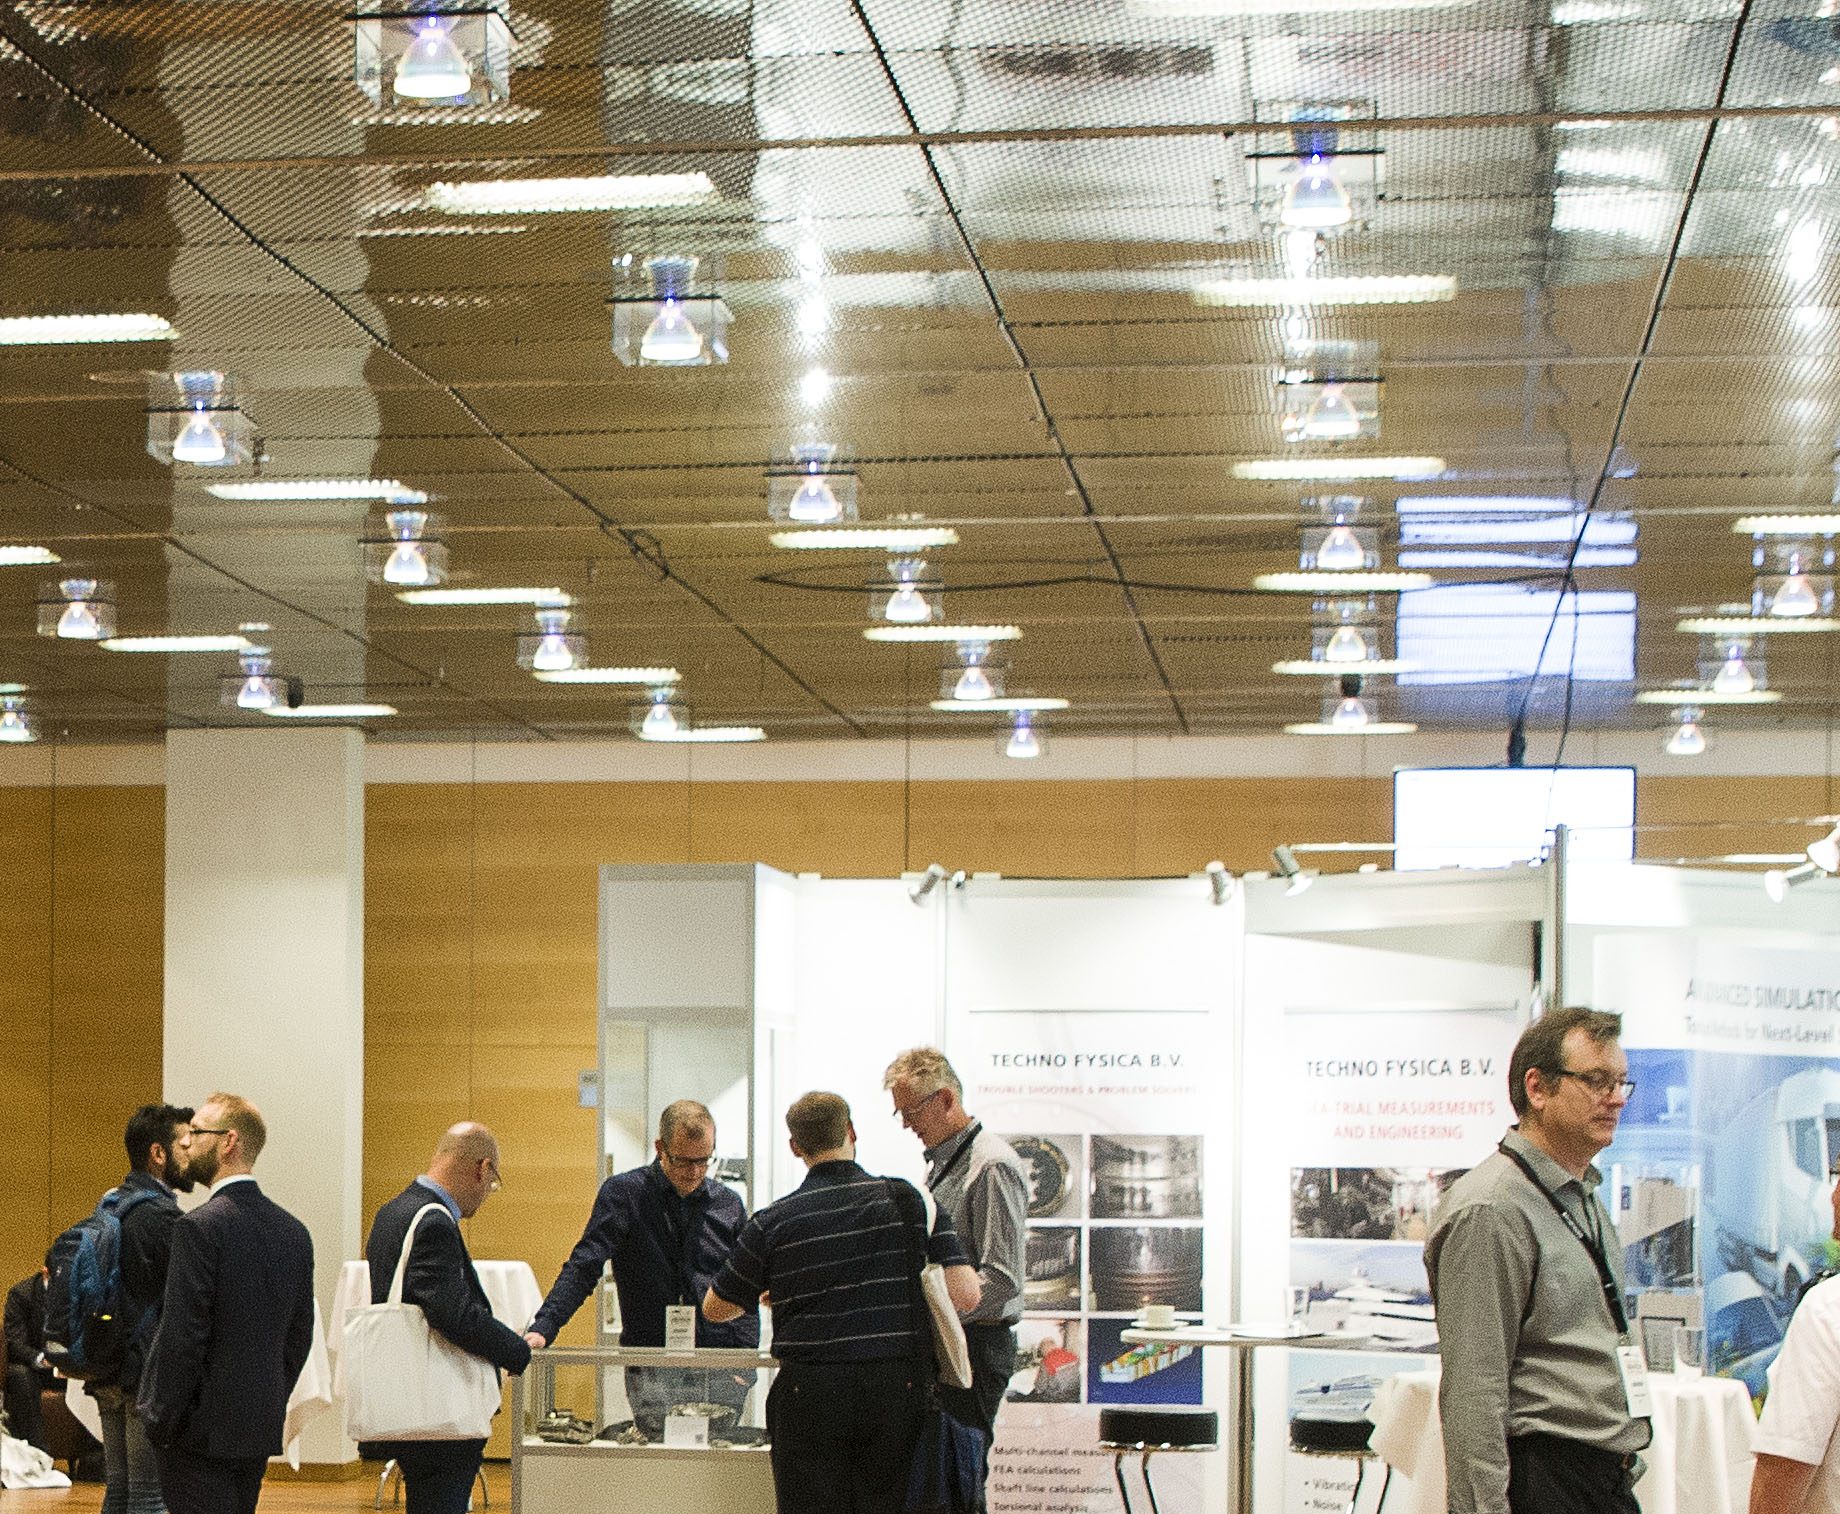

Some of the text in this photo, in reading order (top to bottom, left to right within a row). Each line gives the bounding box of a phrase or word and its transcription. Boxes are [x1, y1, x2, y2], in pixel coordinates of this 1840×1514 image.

[992, 1054, 1067, 1068] TECHNO
[1074, 1054, 1142, 1068] FYSICA
[1306, 1059, 1378, 1078] TECHNO
[1386, 1058, 1452, 1077] FYSICA
[1378, 1100, 1496, 1116] MEASUREMENTS
[1333, 1125, 1464, 1140] AND ENGINEERING
[993, 1466, 1081, 1476] FEA calculations
[1049, 1485, 1113, 1495] calculations
[994, 1502, 1042, 1512] Torsional
